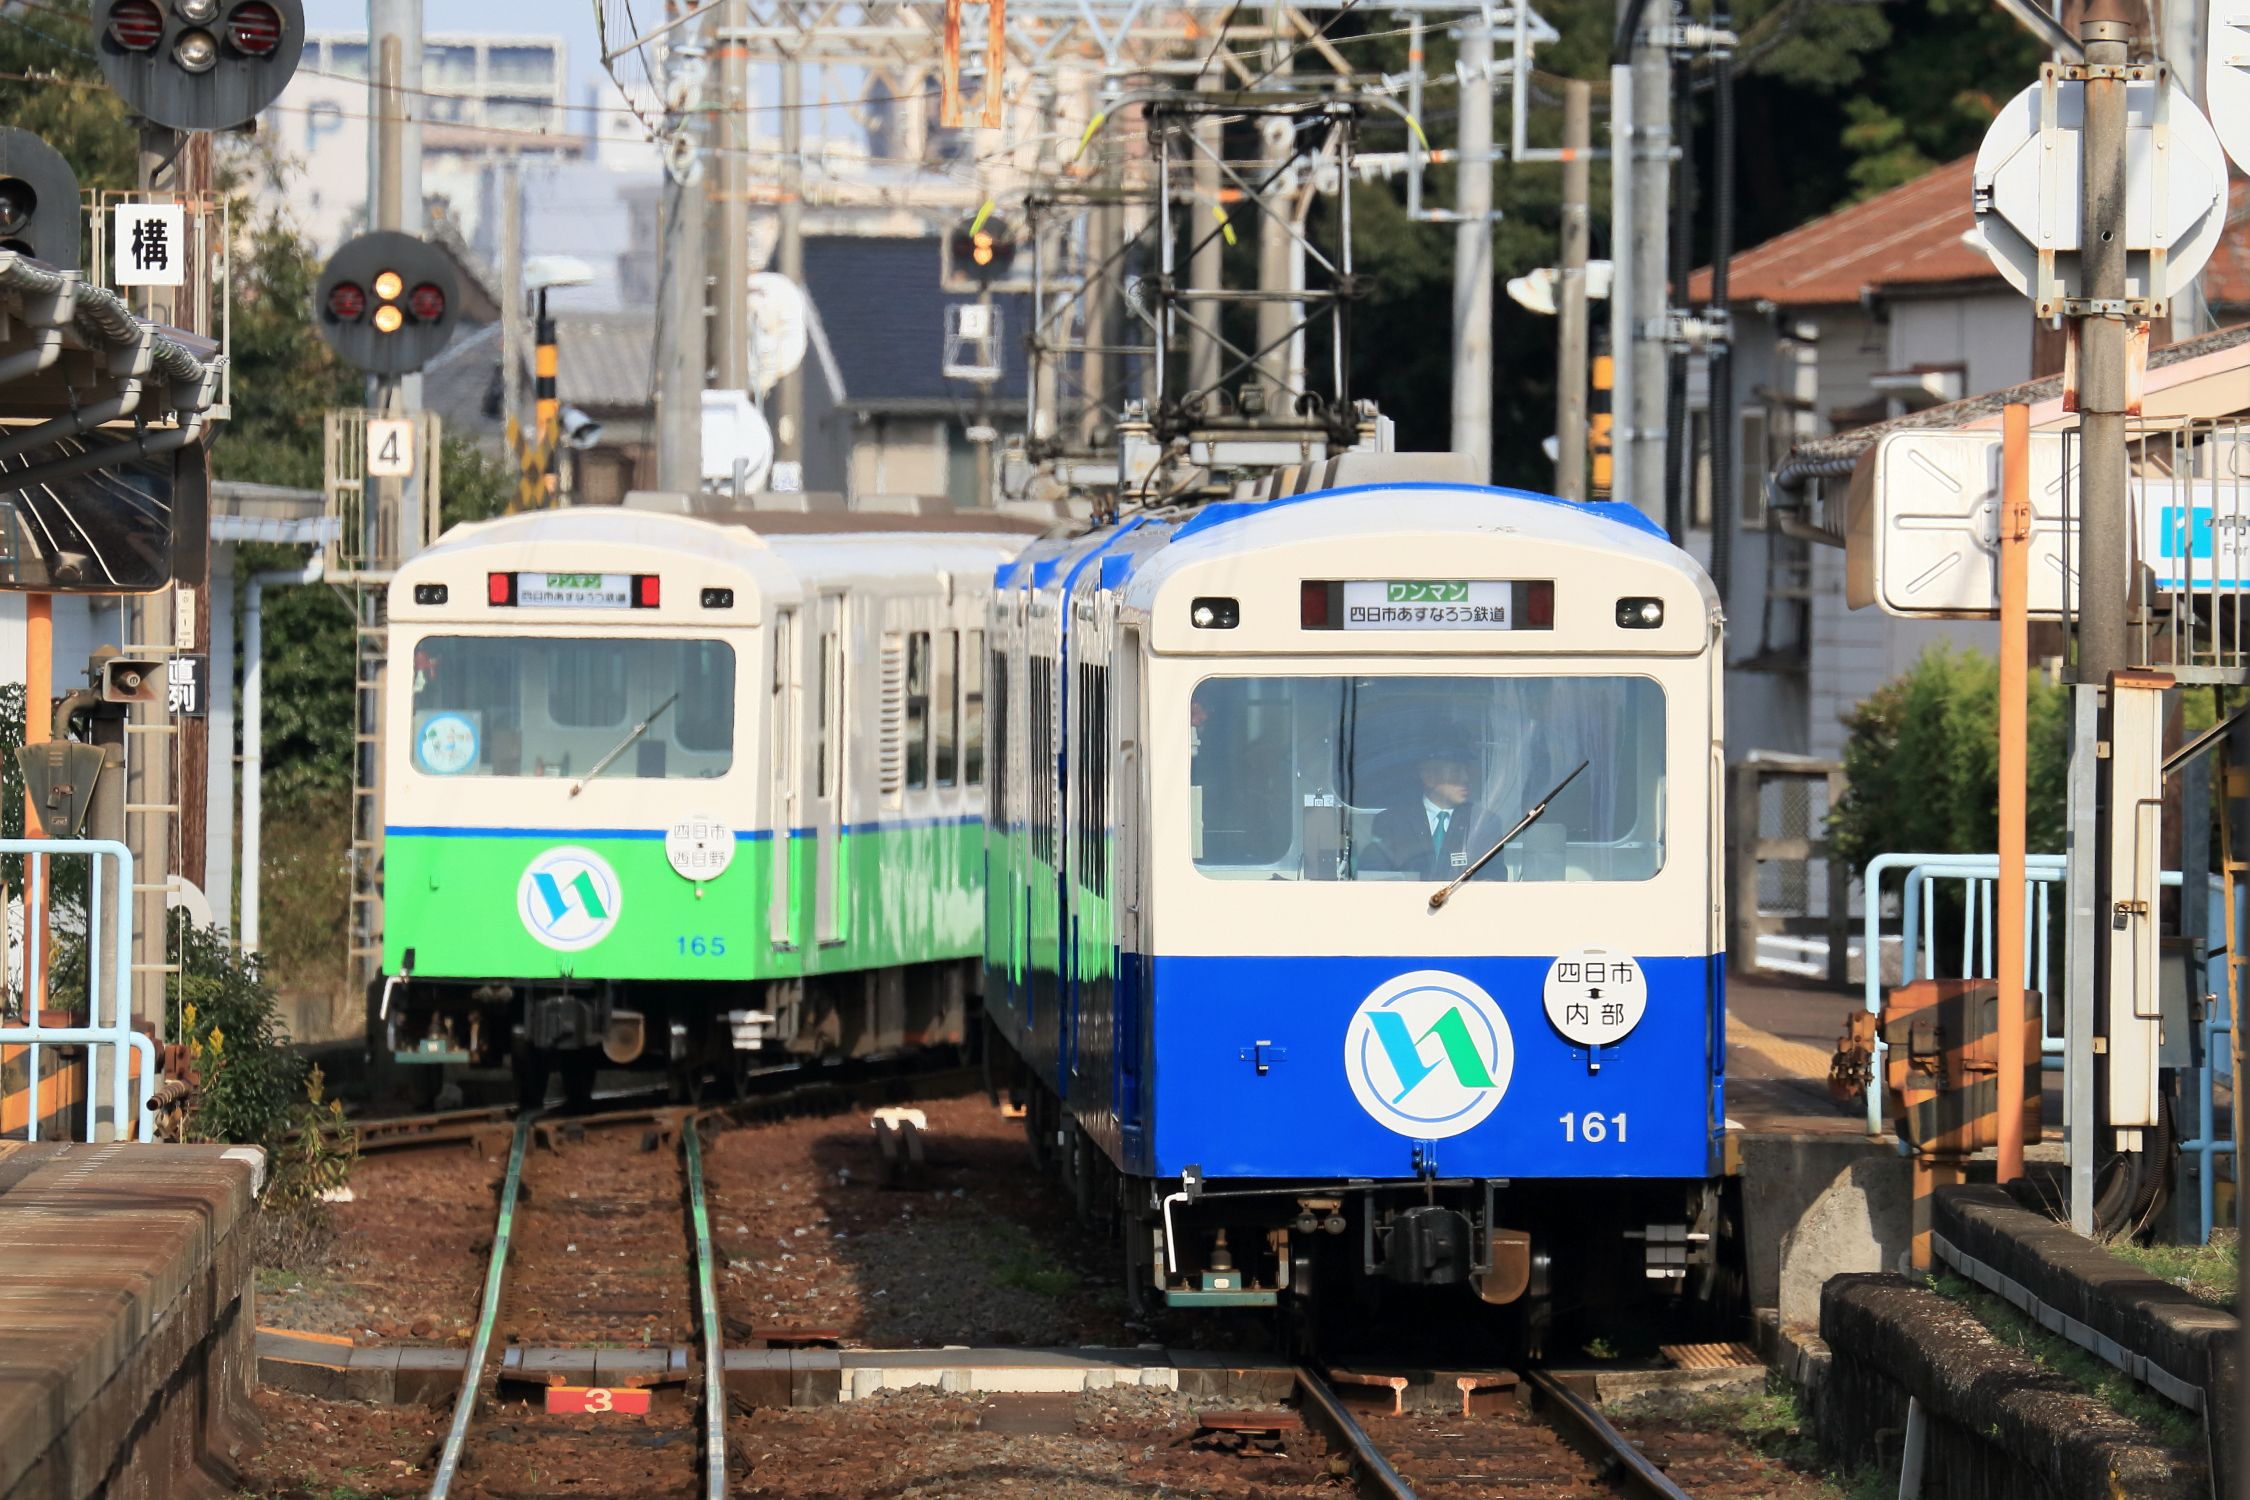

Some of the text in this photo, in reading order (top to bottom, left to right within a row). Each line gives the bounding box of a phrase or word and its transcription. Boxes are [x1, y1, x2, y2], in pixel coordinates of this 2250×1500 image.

[131, 219, 168, 270] 構
[379, 430, 400, 465] 4
[1389, 583, 1466, 600] ワンマン
[1350, 606, 1505, 622] 四日市あすなろう鉄道
[674, 823, 725, 841] 四日市
[677, 935, 726, 957] 165
[1558, 962, 1634, 984] 四日市
[1566, 1003, 1625, 1026] 内部
[1559, 1112, 1628, 1143] 161
[584, 1388, 613, 1414] 3
